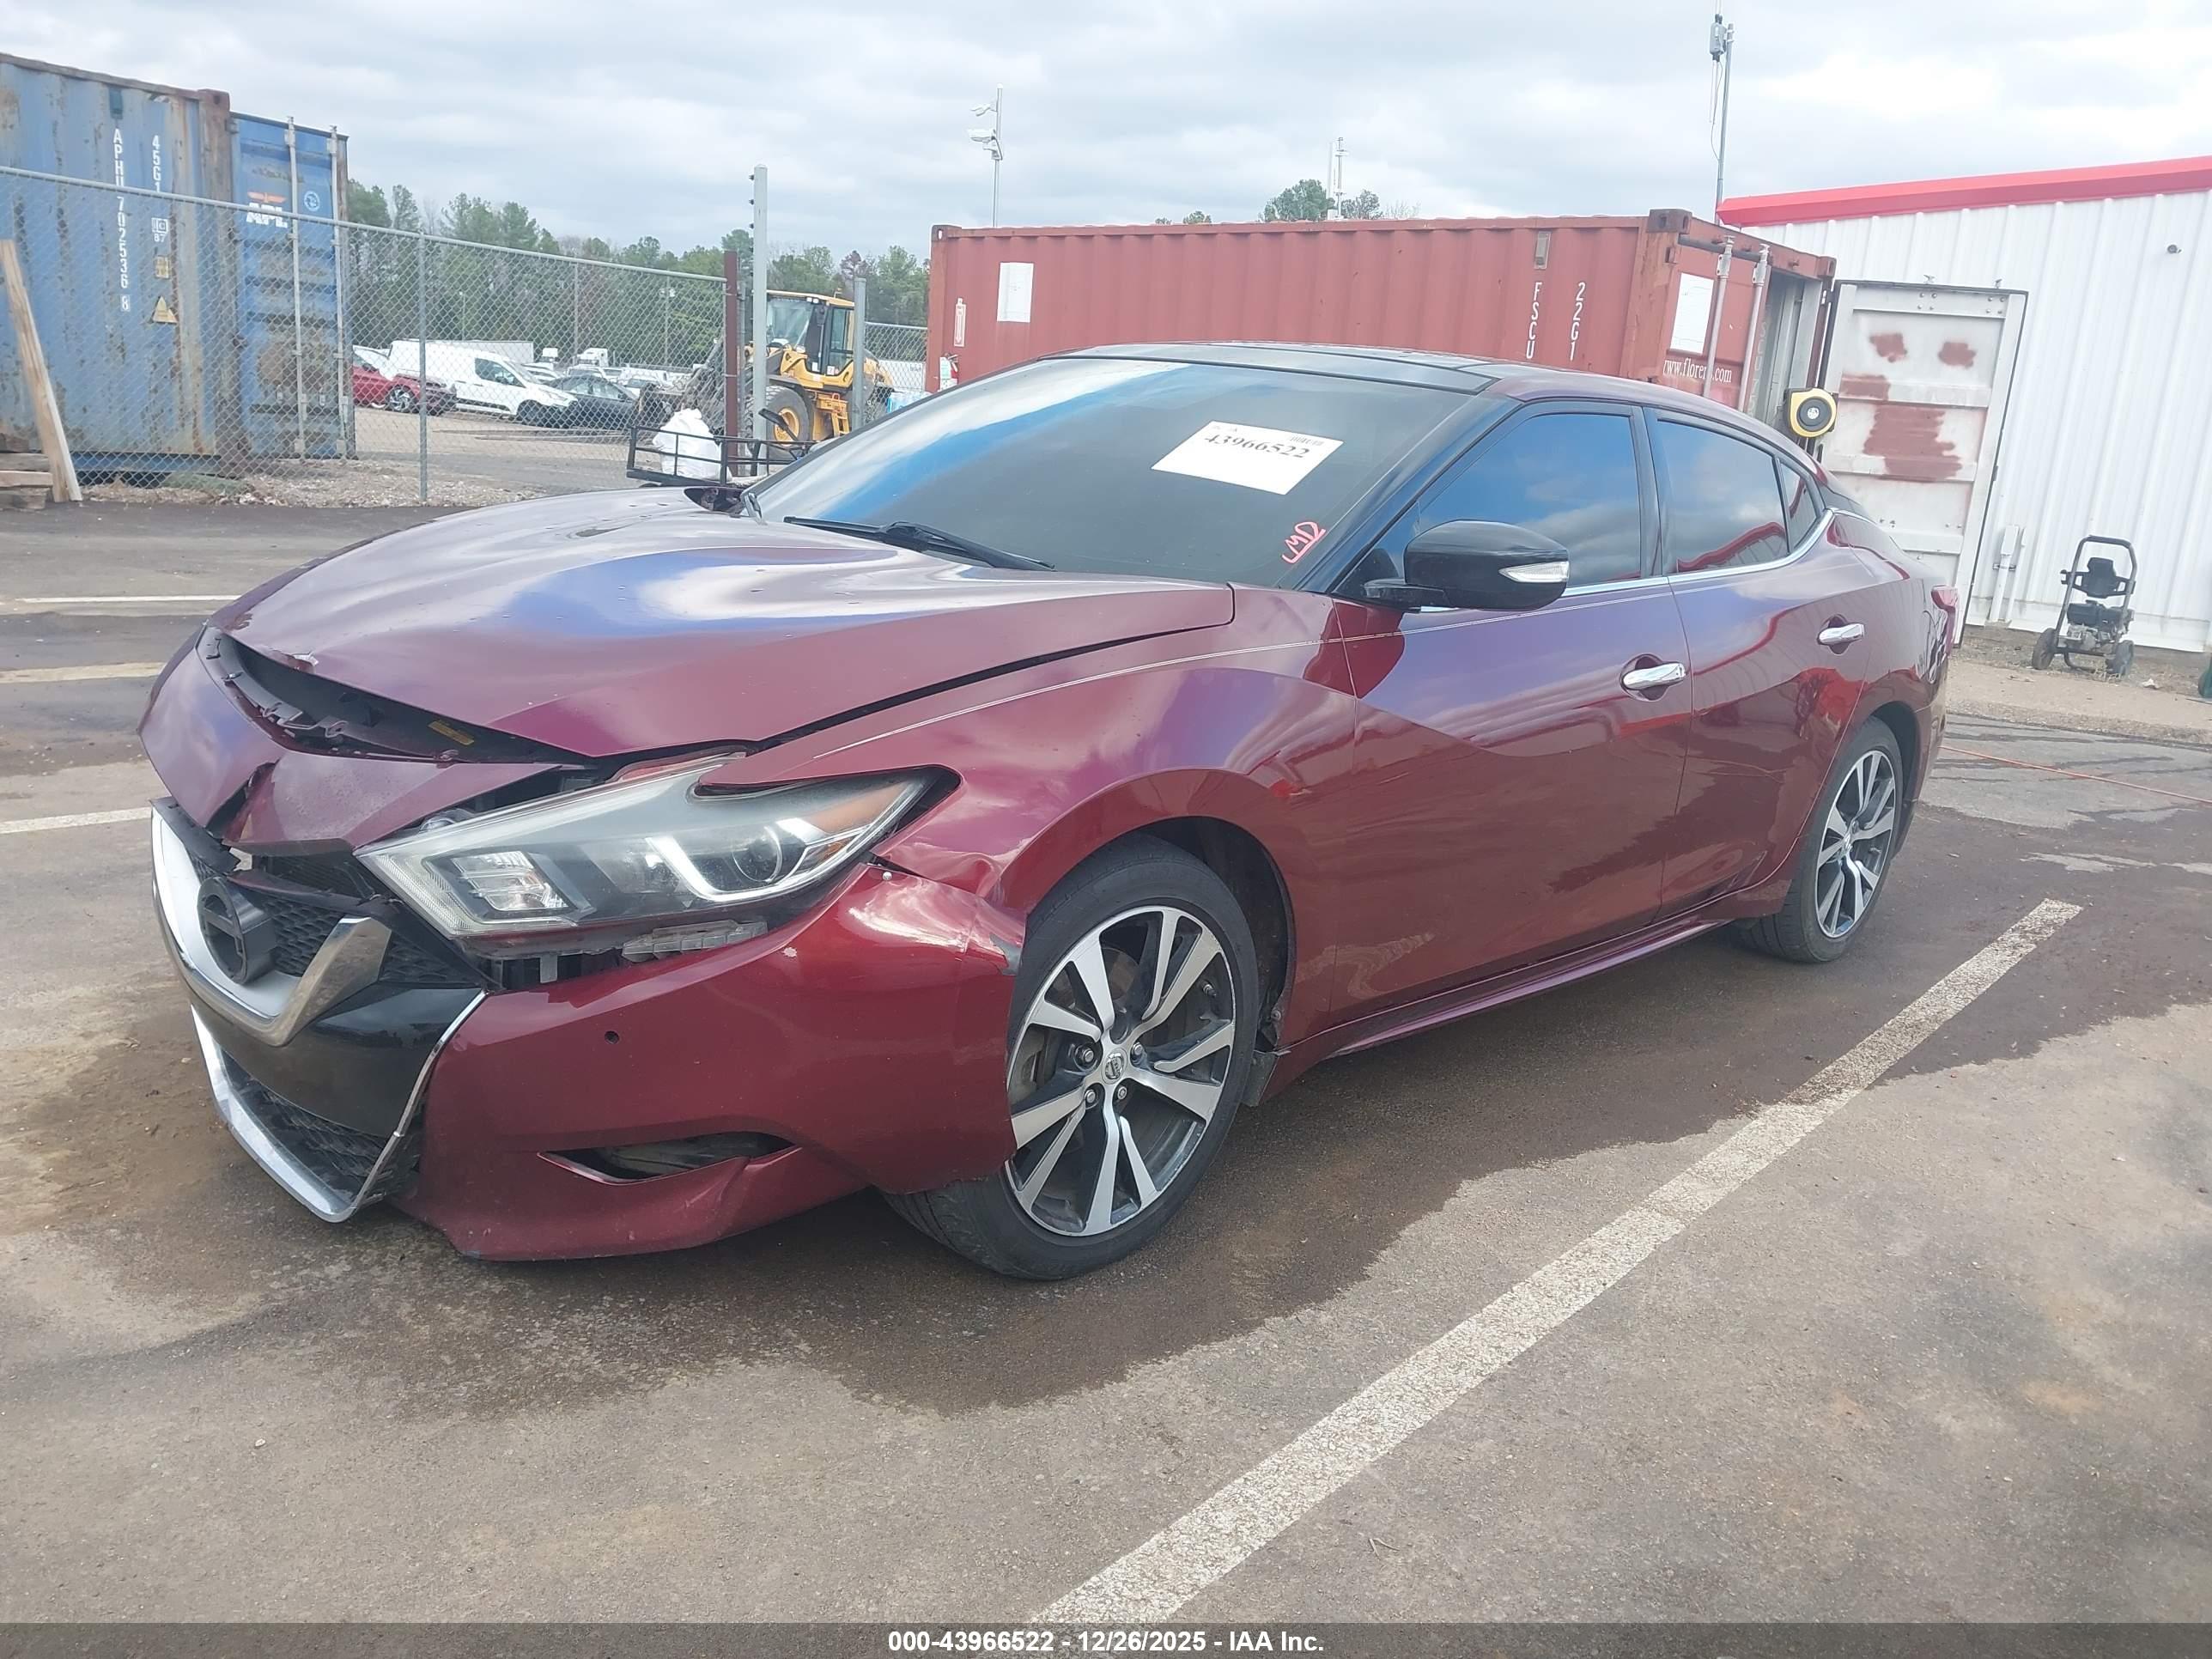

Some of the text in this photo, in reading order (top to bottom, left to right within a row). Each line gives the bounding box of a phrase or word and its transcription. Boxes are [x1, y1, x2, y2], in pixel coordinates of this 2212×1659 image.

[152, 135, 161, 193] 45G1
[117, 197, 129, 289] 702536
[1526, 282, 1542, 359] FSCU
[1570, 282, 1586, 361] 22G1
[1205, 434, 1310, 459] 43966522
